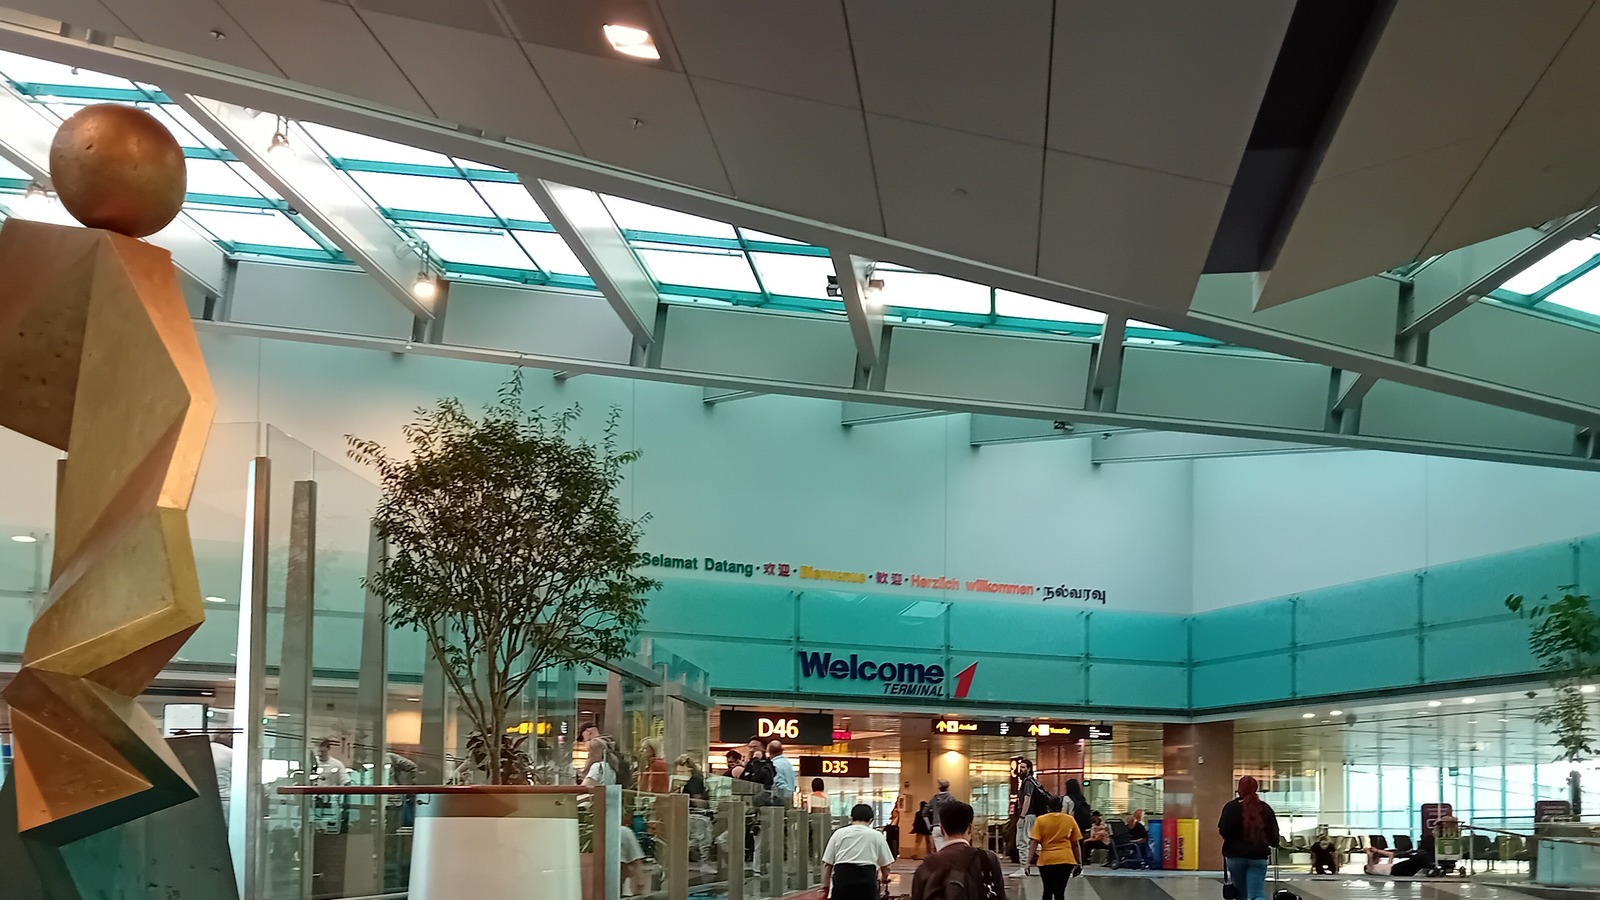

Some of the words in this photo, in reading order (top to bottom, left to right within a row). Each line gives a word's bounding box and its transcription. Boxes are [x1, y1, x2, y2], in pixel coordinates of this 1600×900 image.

[642, 552, 698, 570] Selamat
[705, 558, 753, 577] Datang
[763, 563, 790, 577] 欢迎
[911, 574, 960, 591] Herzlich
[965, 579, 1034, 596] willkommen
[1043, 583, 1106, 604] நல்வரவு
[800, 651, 945, 683] Welcome
[883, 682, 944, 697] TERMINAL
[953, 661, 979, 698] 1
[757, 718, 799, 738] D46
[822, 760, 849, 774] D35
